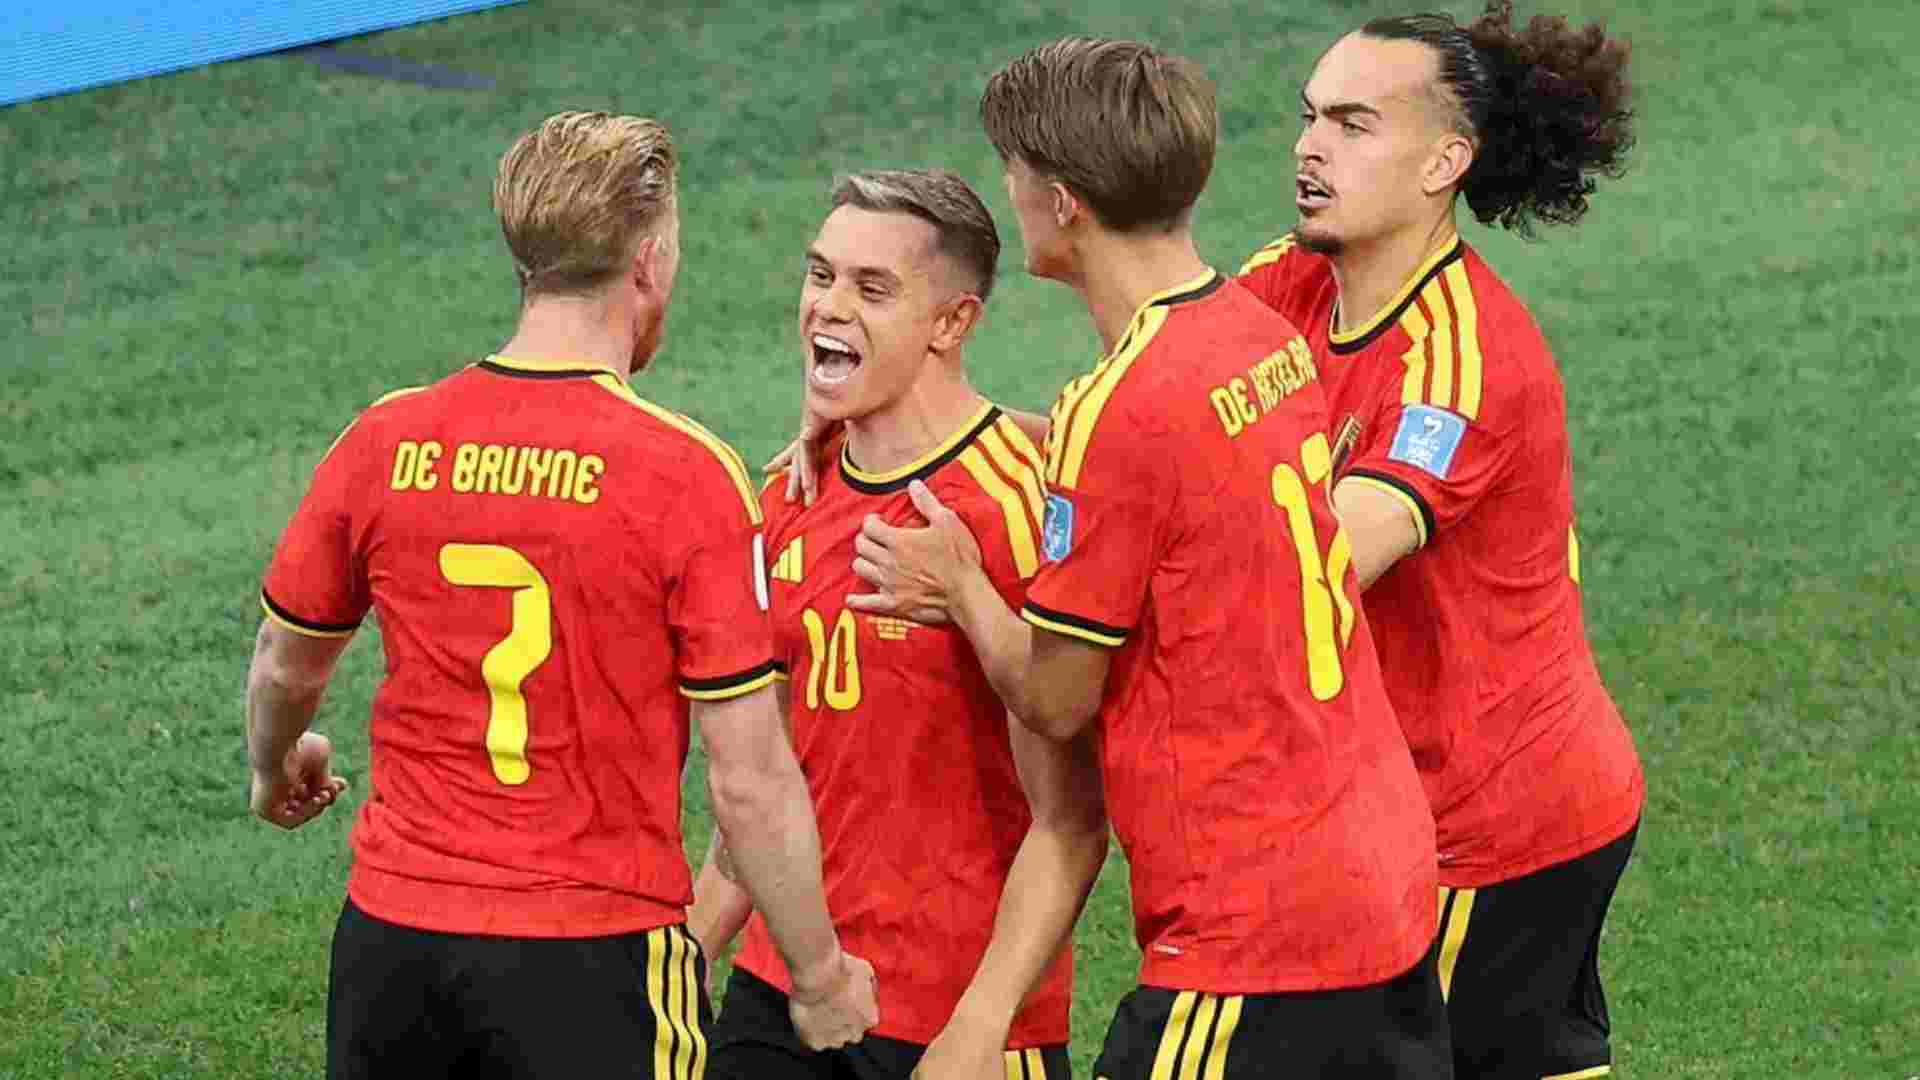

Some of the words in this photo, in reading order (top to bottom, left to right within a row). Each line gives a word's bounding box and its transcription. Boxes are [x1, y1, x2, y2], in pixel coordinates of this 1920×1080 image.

[1209, 377, 1258, 438] DE
[390, 441, 443, 491] DE
[451, 443, 605, 504] BRUYNE
[438, 542, 553, 786] 7
[801, 607, 862, 711] 10
